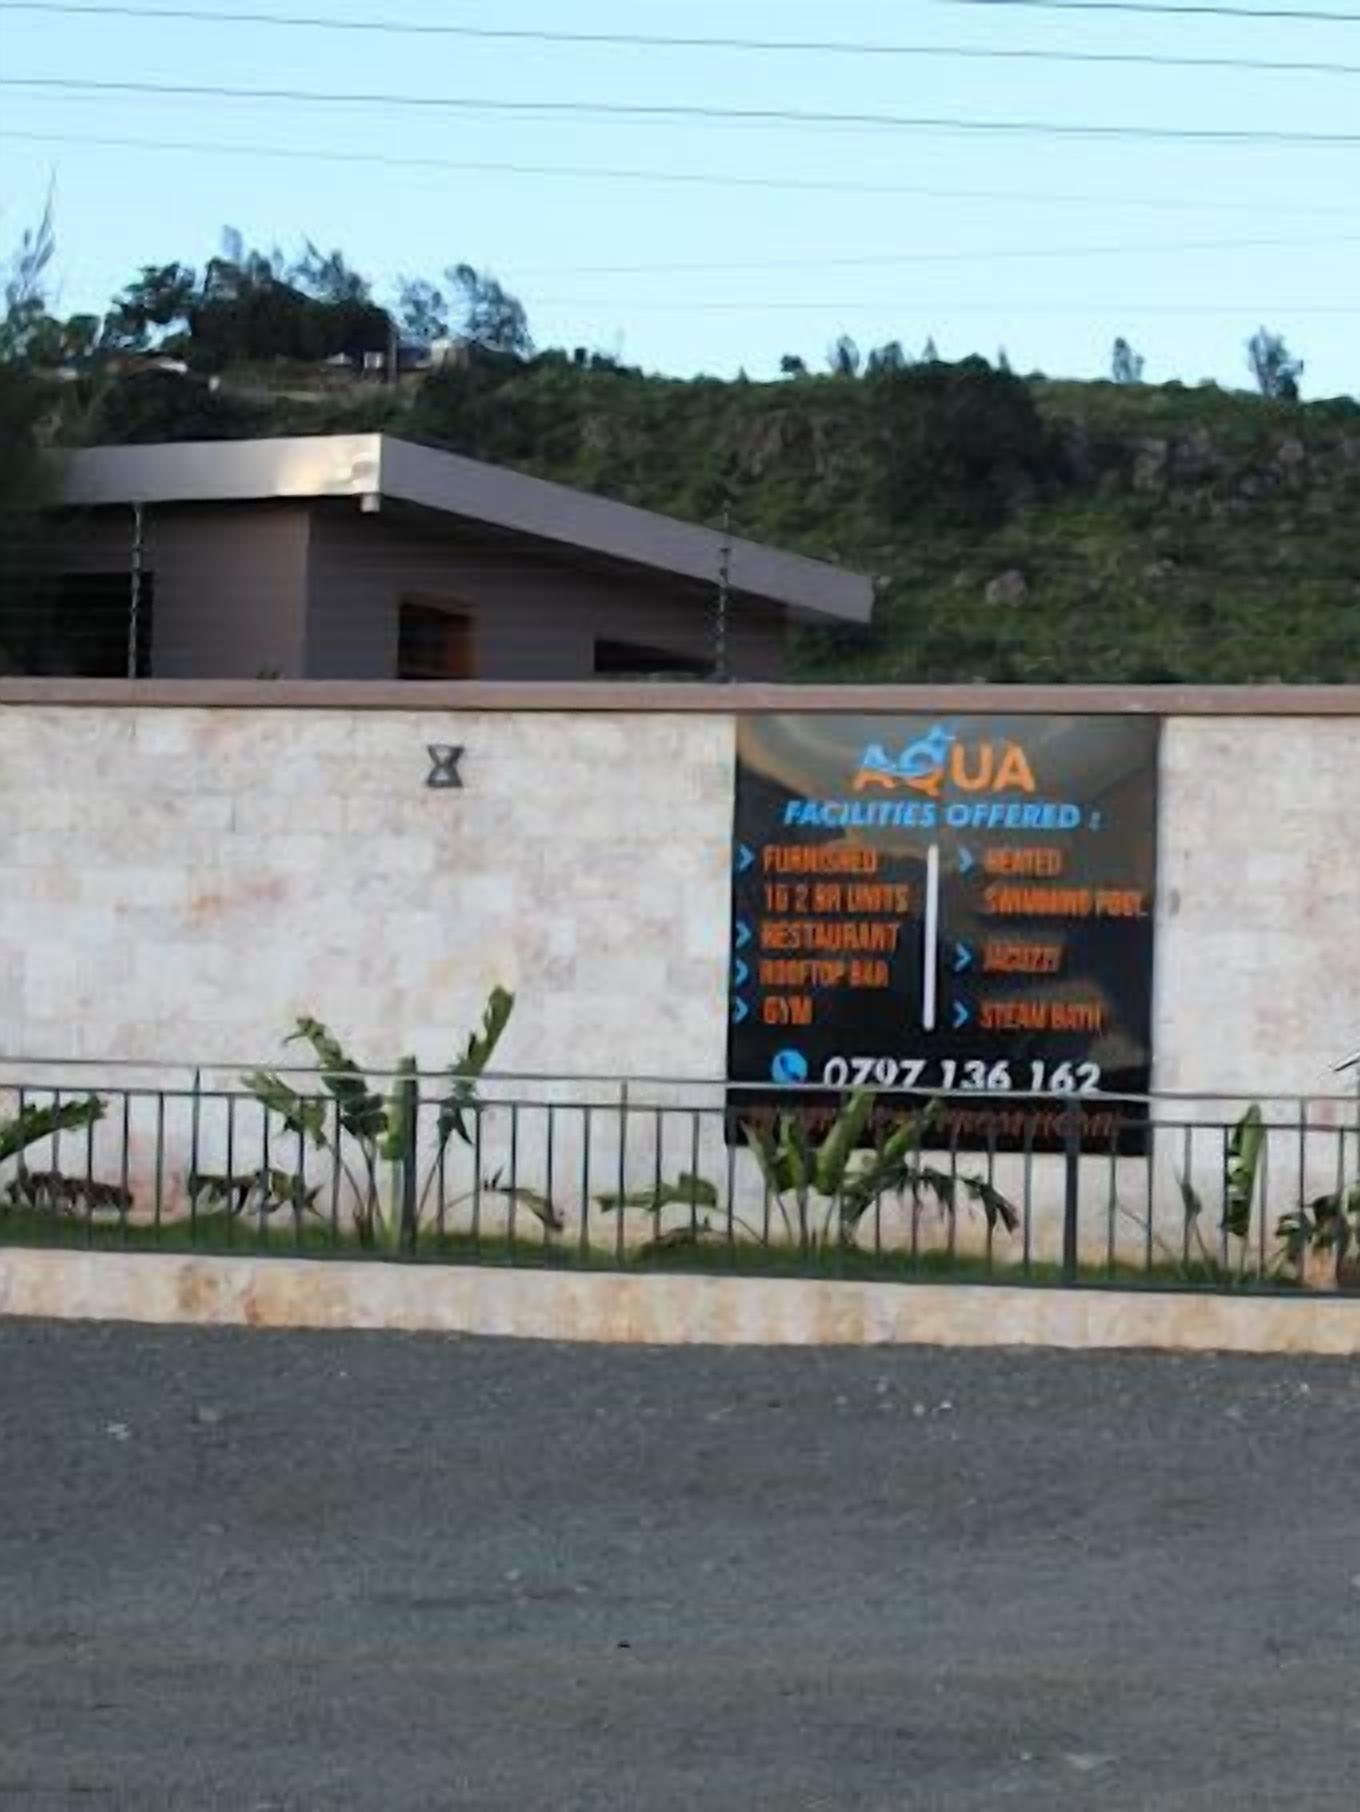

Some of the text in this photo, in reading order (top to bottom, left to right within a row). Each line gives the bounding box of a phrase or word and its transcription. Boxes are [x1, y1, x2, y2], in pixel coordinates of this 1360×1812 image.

[852, 724, 1036, 797] AQUA
[784, 801, 937, 827] FACILITIES
[945, 803, 1081, 829] OFFERED
[941, 1058, 1012, 1090] 136
[1031, 1060, 1101, 1094] 162
